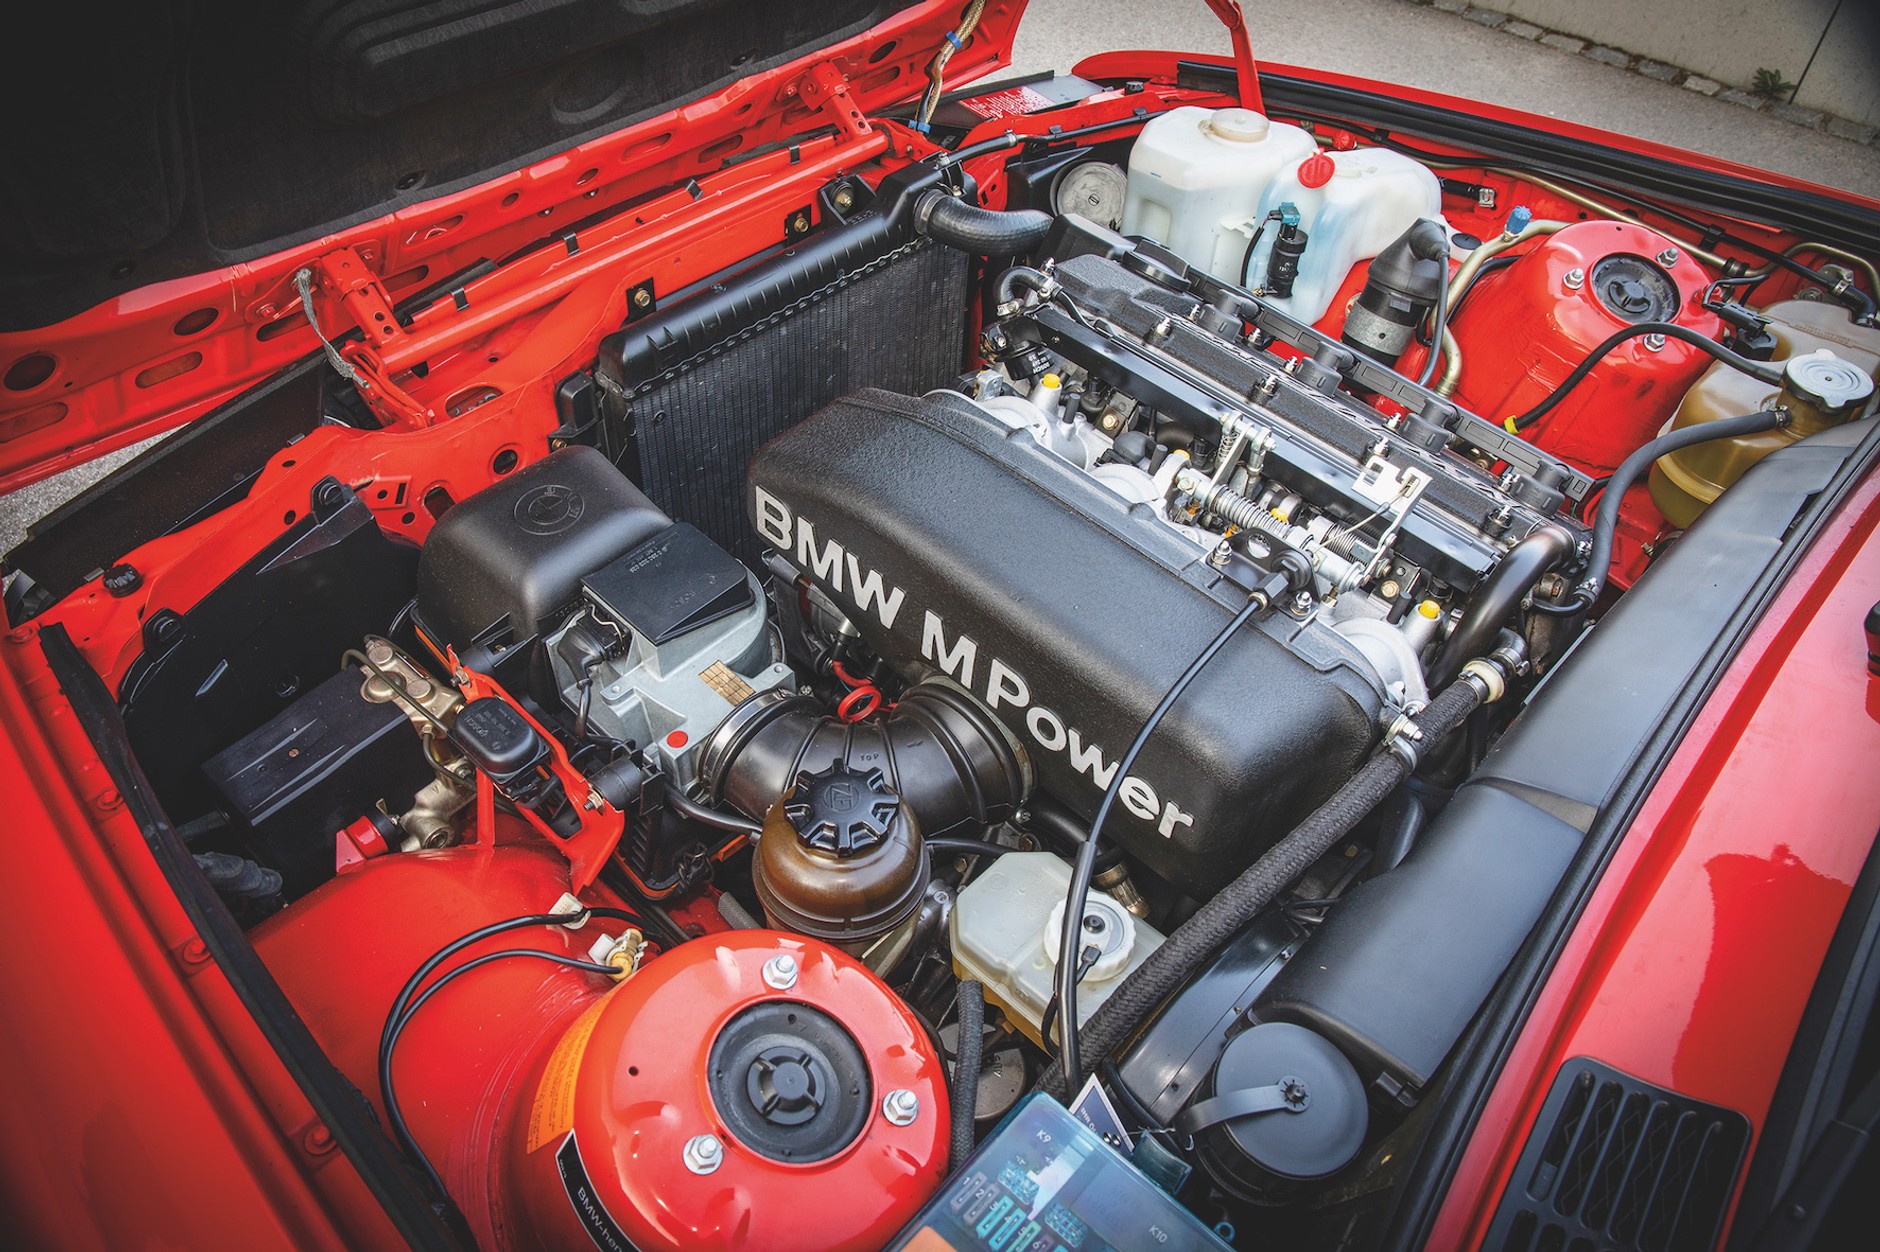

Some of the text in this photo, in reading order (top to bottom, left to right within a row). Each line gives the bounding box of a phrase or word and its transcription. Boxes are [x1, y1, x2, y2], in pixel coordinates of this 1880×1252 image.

[755, 485, 1195, 840] BMW M Power
[860, 752, 879, 762] TOP
[1036, 1129, 1052, 1143] K9
[975, 1188, 985, 1199] 2
[1149, 1224, 1168, 1244] K10
[1032, 1240, 1042, 1250] 6
